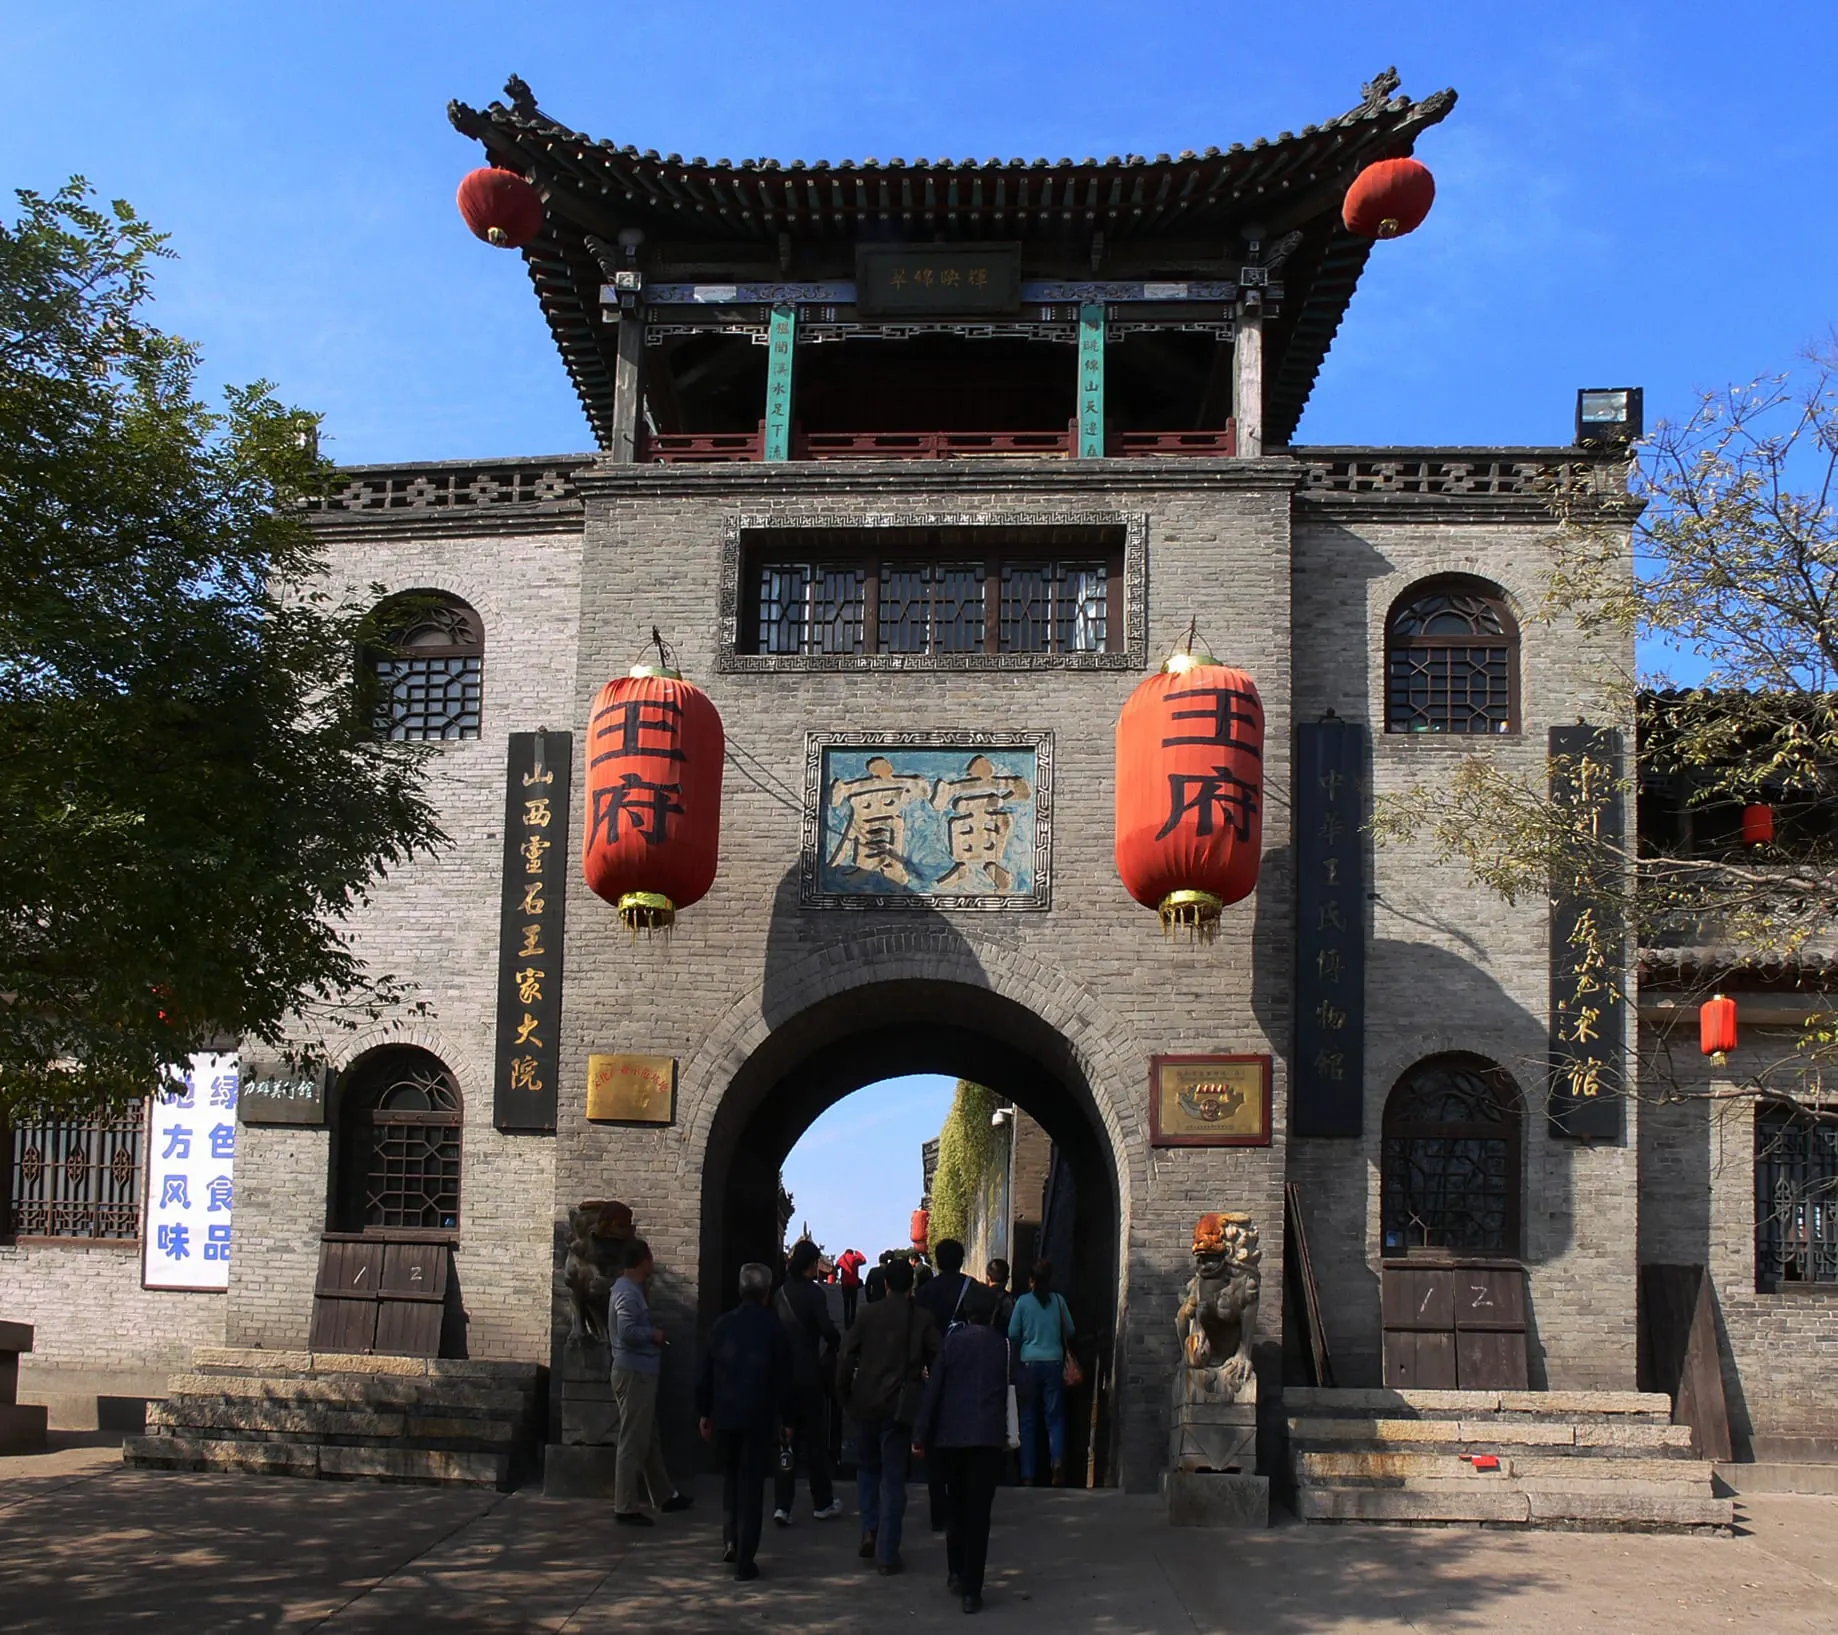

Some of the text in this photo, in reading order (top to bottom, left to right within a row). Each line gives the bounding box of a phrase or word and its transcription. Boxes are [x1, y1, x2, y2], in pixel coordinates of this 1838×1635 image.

[587, 700, 688, 857] 王府
[1155, 688, 1260, 843] 王府
[203, 1075, 238, 1261] 绿色食品
[410, 1266, 423, 1281] 2
